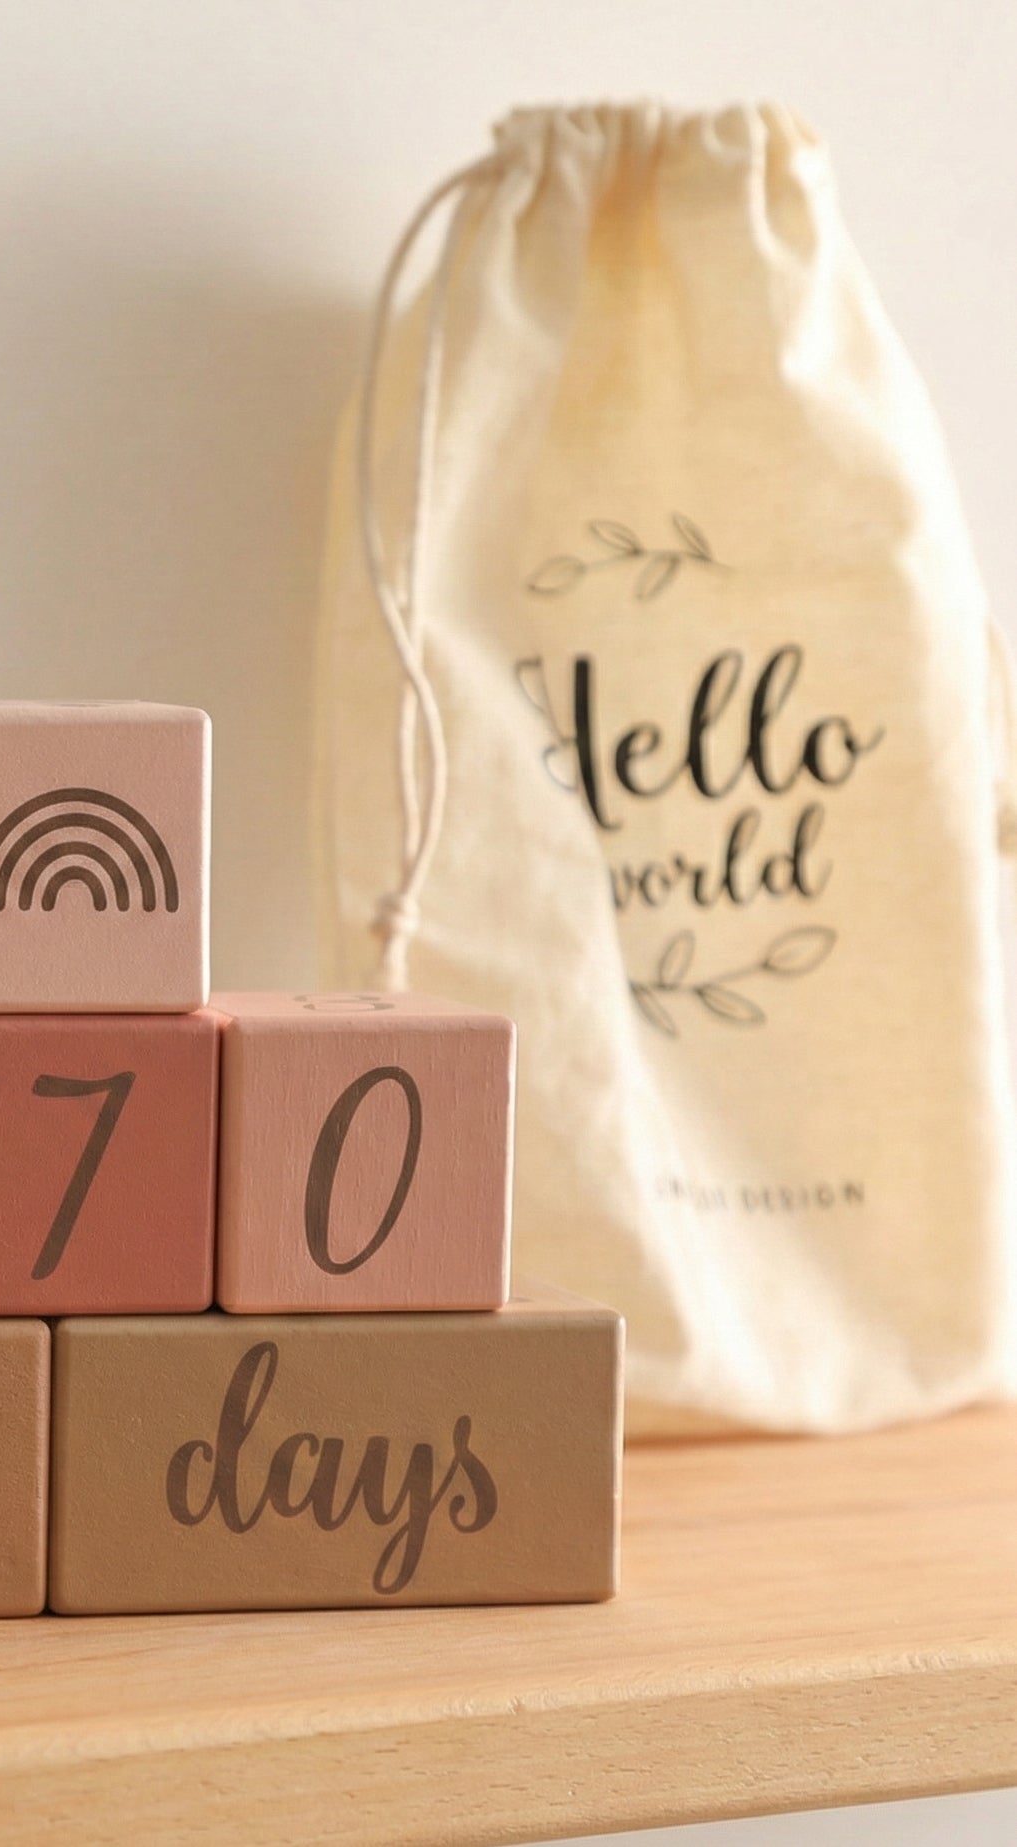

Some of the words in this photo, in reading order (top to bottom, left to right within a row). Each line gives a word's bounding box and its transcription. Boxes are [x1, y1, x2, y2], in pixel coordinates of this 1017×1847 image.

[31, 1071, 136, 1280] 7
[305, 1066, 422, 1275] 0
[166, 1342, 498, 1595] days
